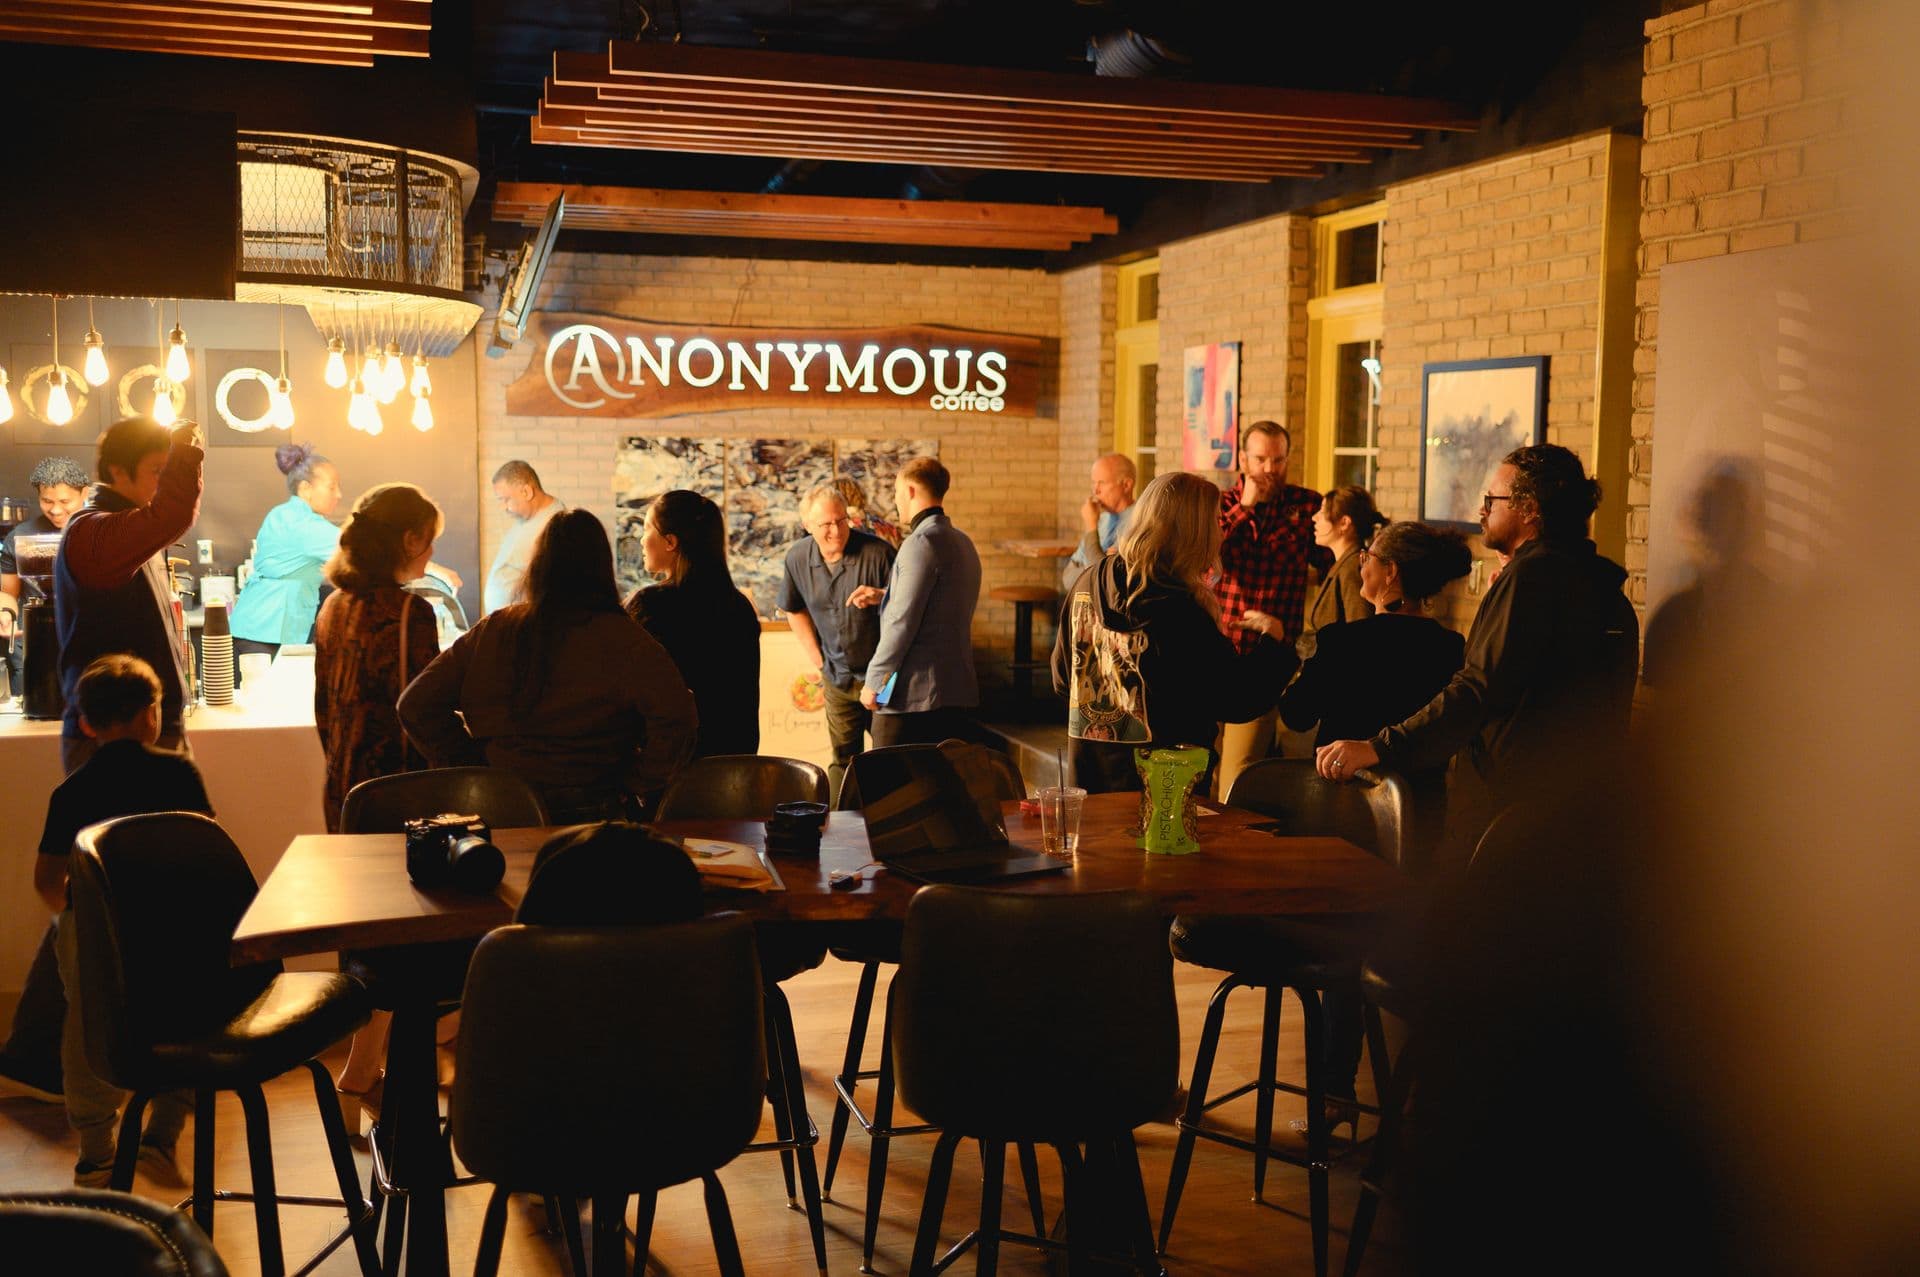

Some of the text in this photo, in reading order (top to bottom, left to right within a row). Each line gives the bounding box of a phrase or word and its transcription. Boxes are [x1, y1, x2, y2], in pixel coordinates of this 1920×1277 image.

[545, 324, 1007, 409] ANONYMOUS
[930, 392, 1005, 411] coffee
[1160, 769, 1175, 841] PISTACHIOS
